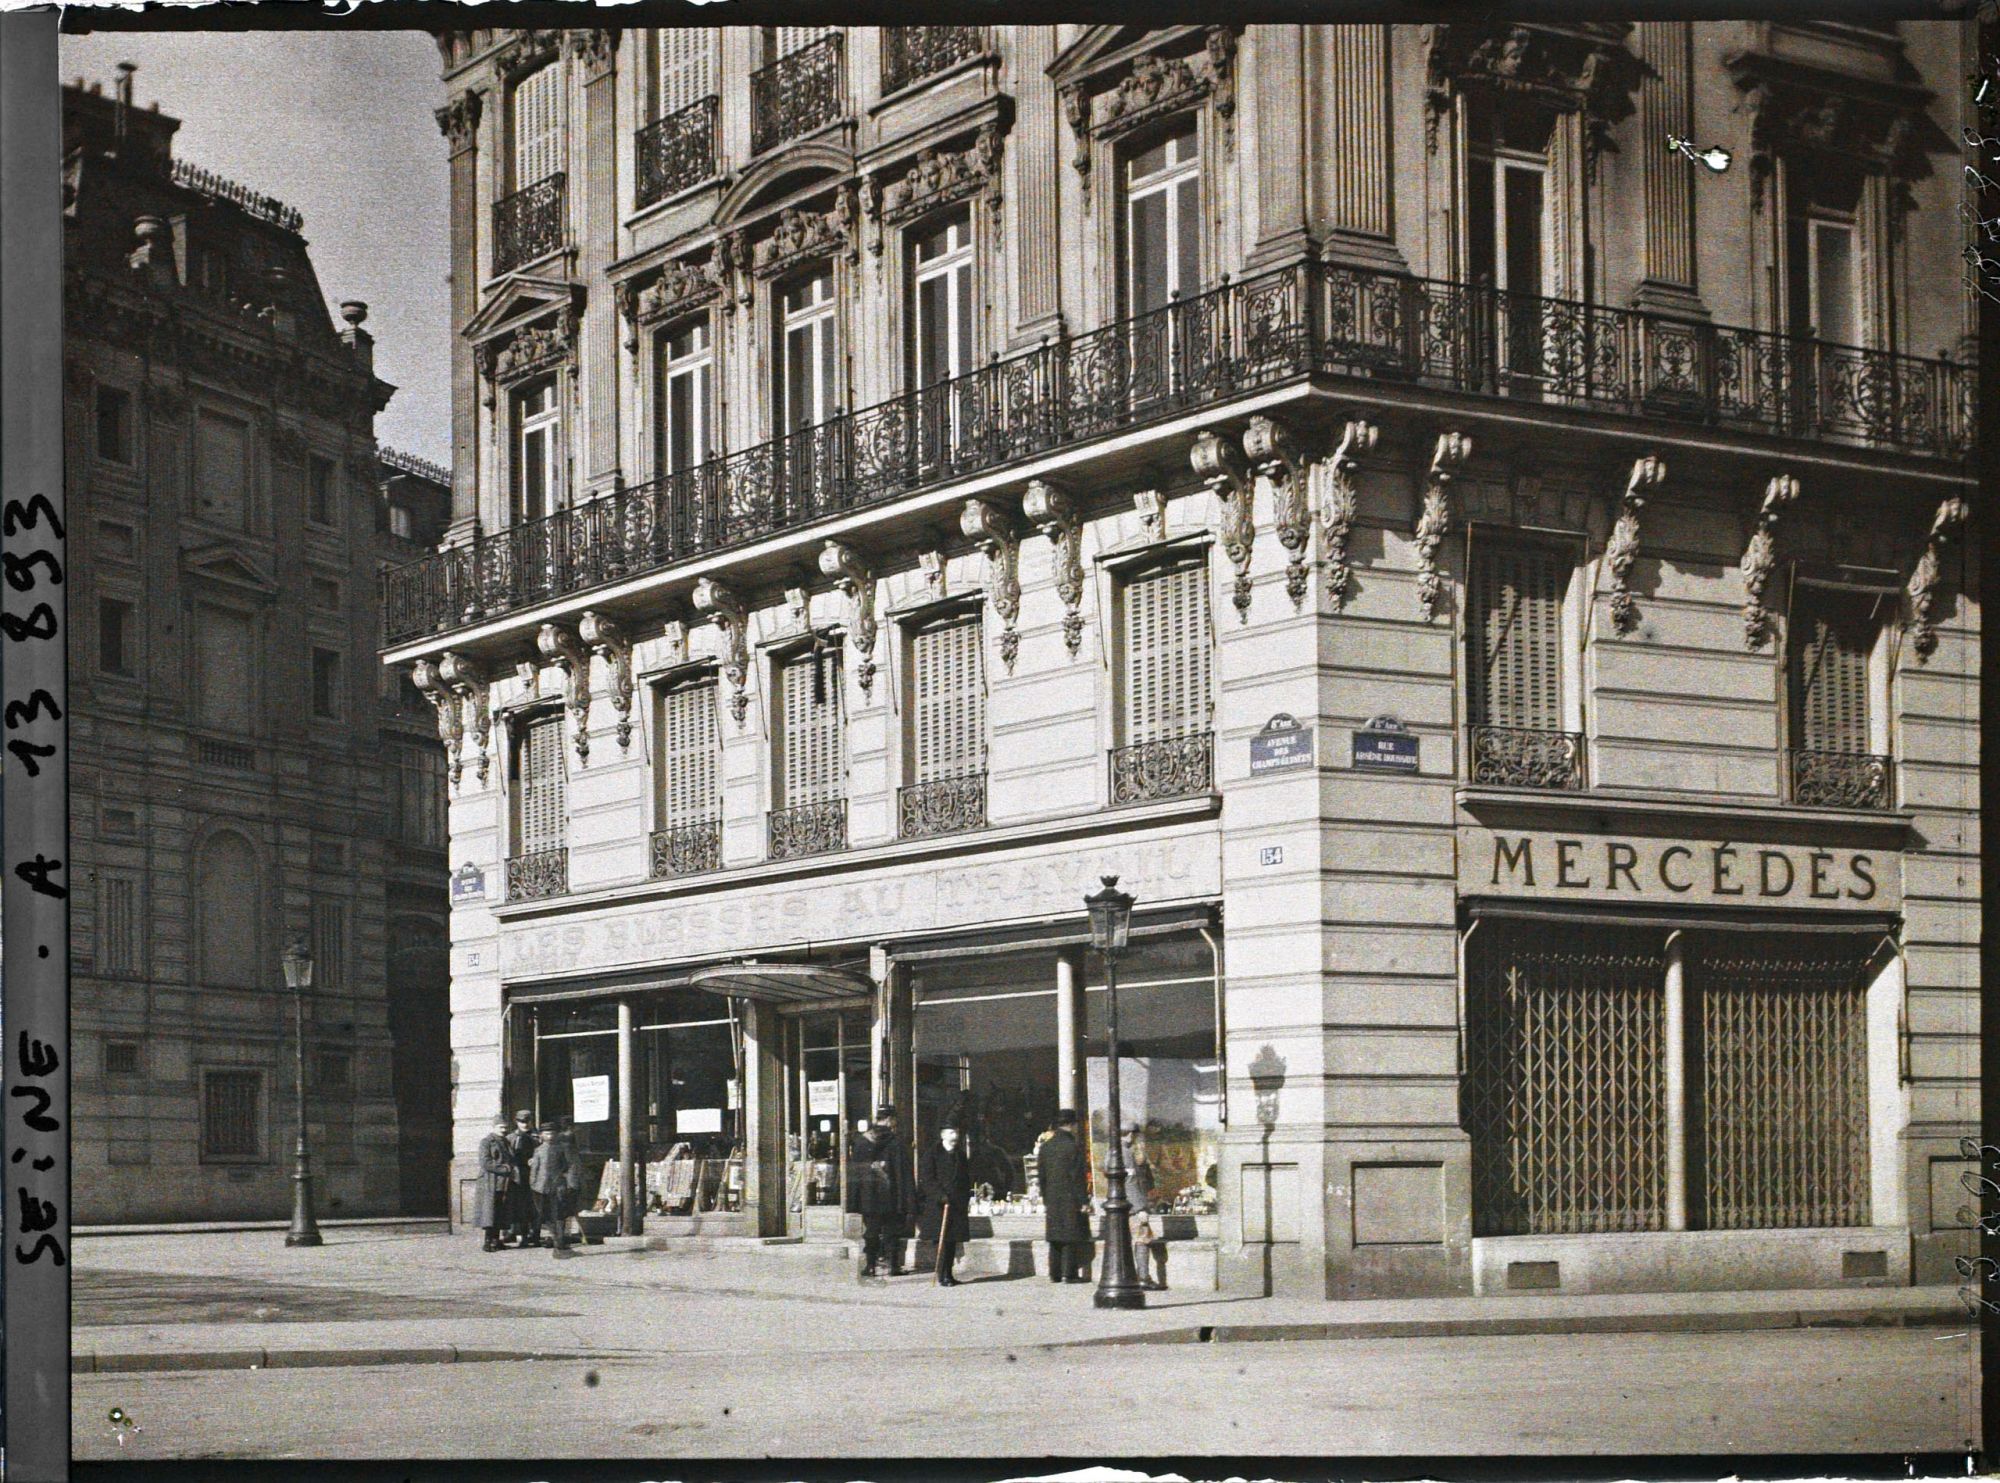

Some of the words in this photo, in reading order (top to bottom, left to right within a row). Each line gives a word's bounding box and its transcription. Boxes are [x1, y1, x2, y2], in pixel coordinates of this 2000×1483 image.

[1, 493, 65, 642] 893
[5, 688, 63, 777] 13
[1267, 735, 1297, 748] AVENUE
[1378, 741, 1394, 751] RUE
[1261, 847, 1281, 865] 154
[14, 853, 68, 900] A
